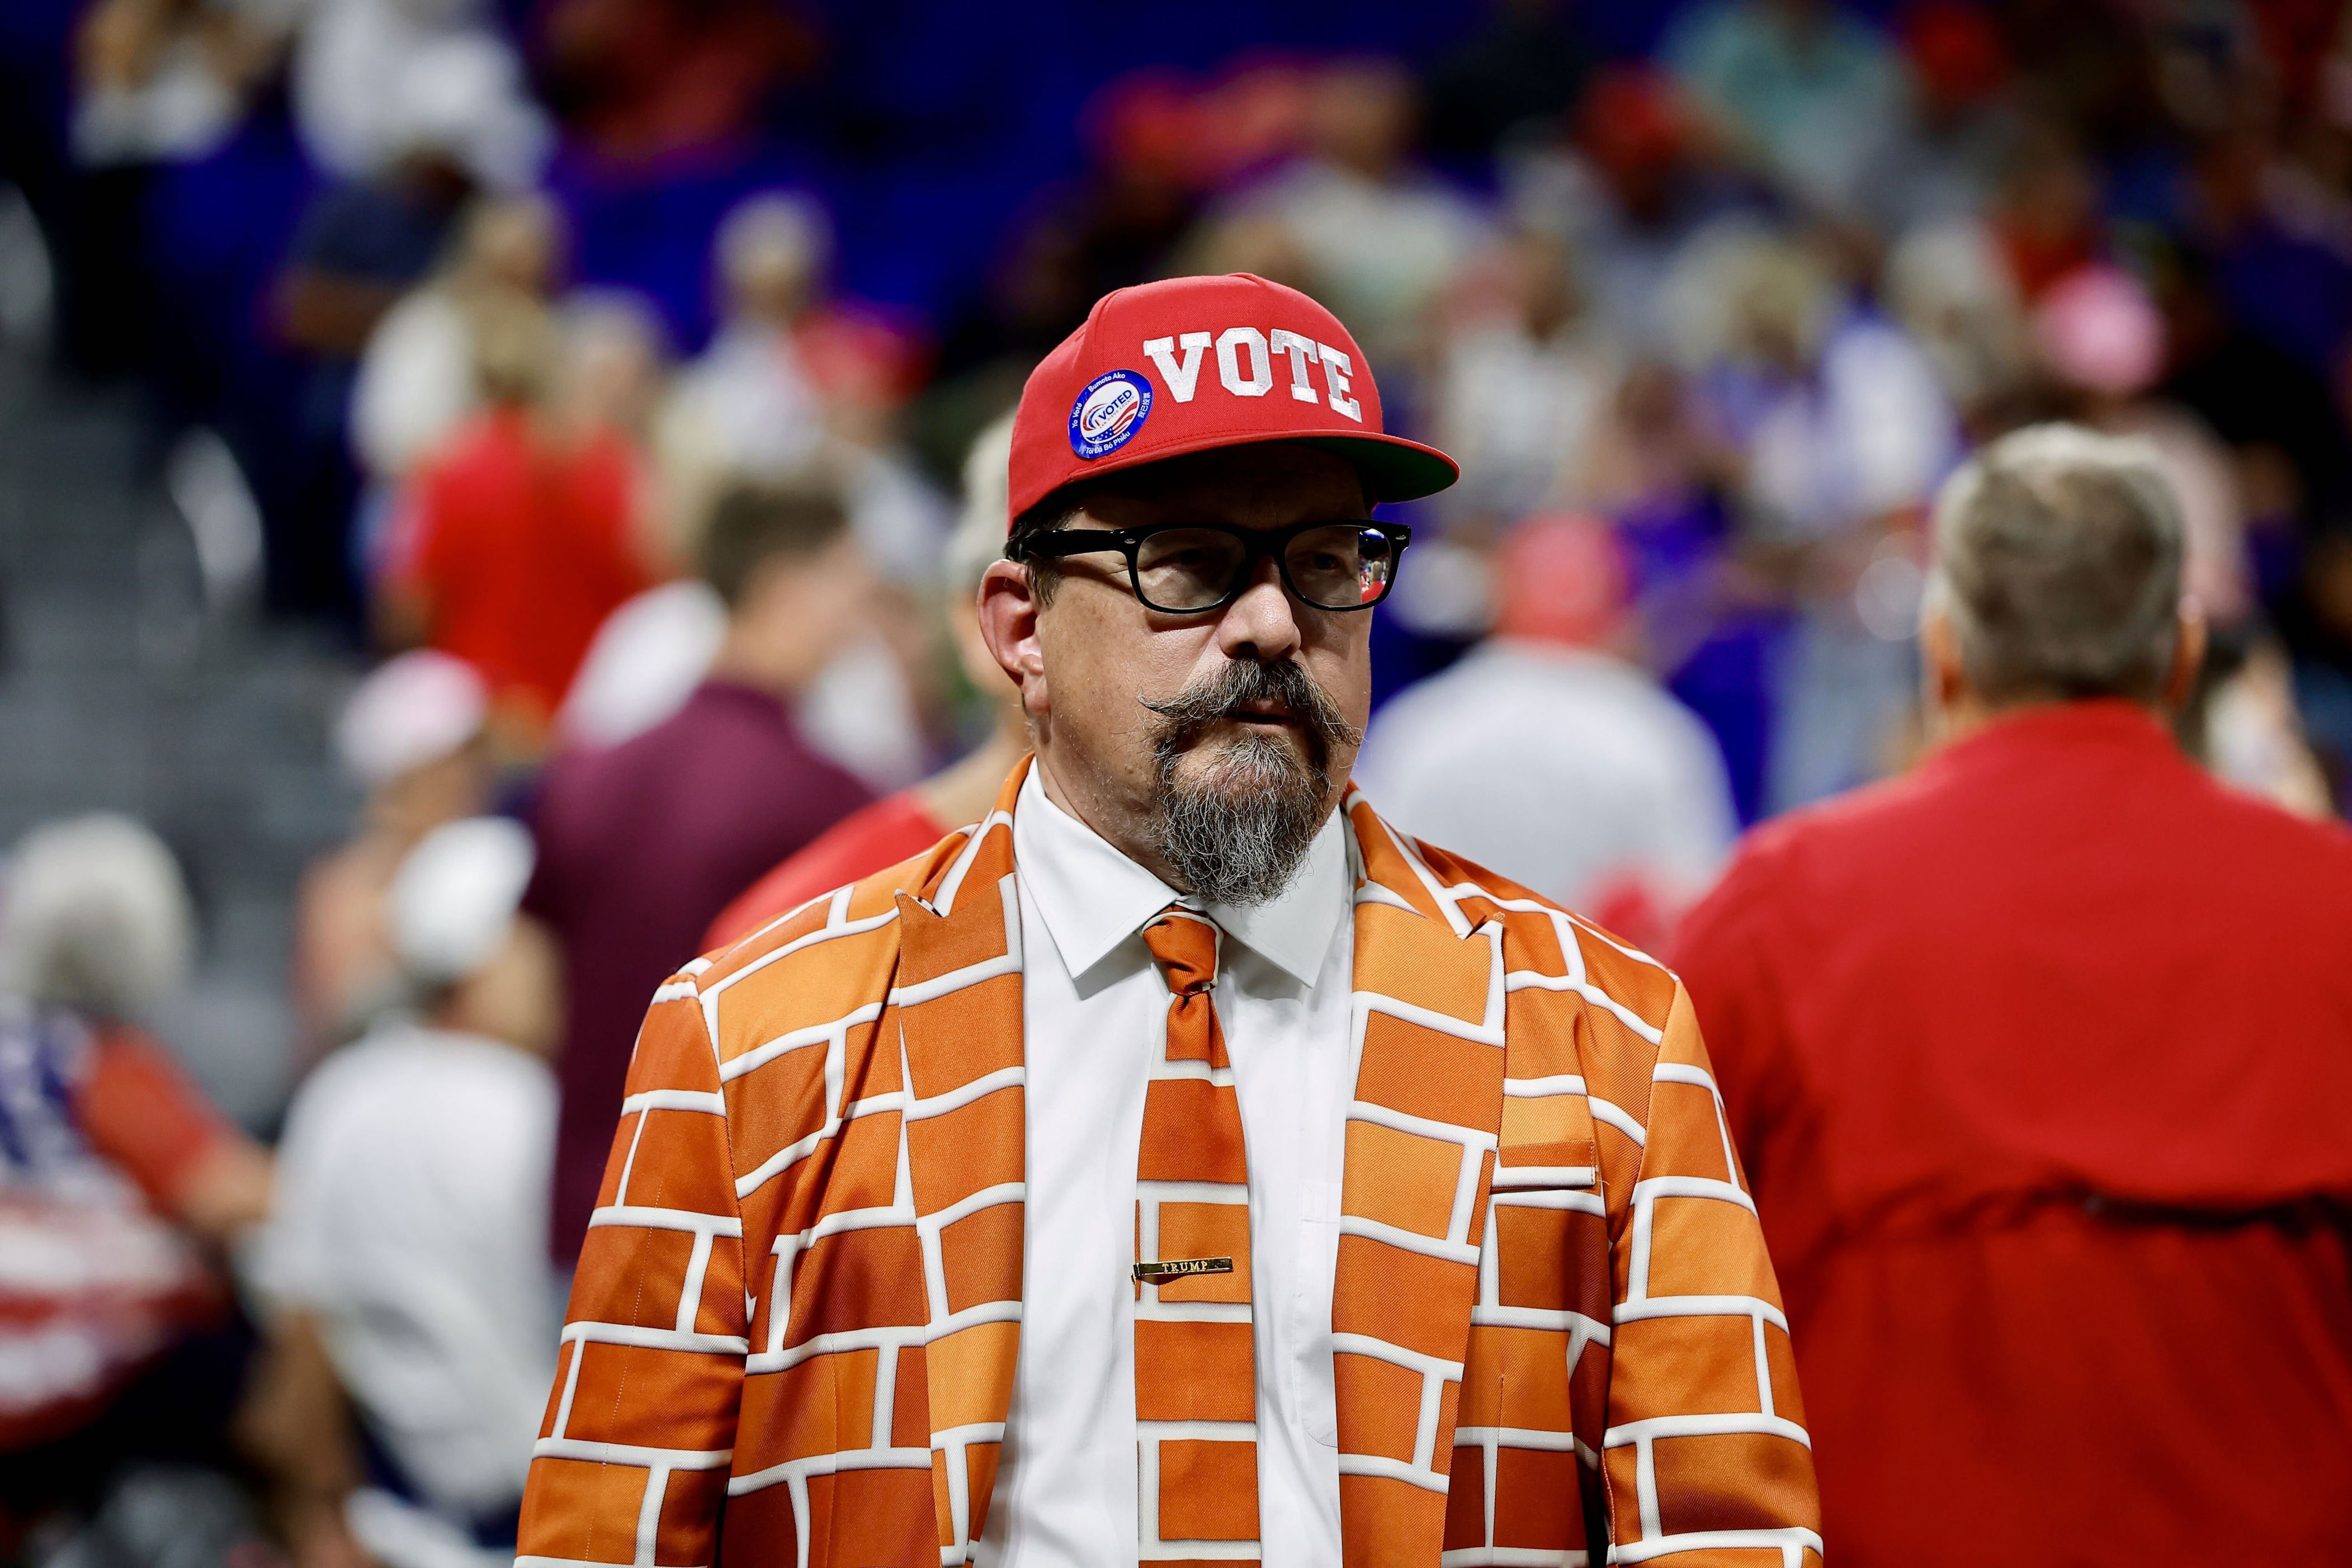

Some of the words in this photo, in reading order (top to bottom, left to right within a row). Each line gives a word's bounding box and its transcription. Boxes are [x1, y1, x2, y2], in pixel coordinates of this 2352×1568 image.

[1088, 376, 1112, 392] Bumoto
[1143, 327, 1362, 423] VOTE
[1073, 402, 1083, 418] Voté
[1098, 390, 1132, 420] VOTED
[1107, 410, 1119, 421] DIEGO
[1119, 396, 1134, 409] COUNTY
[1137, 392, 1151, 418] 我已投票
[1072, 419, 1078, 428] Yo
[1162, 1260, 1208, 1272] TRUMP
